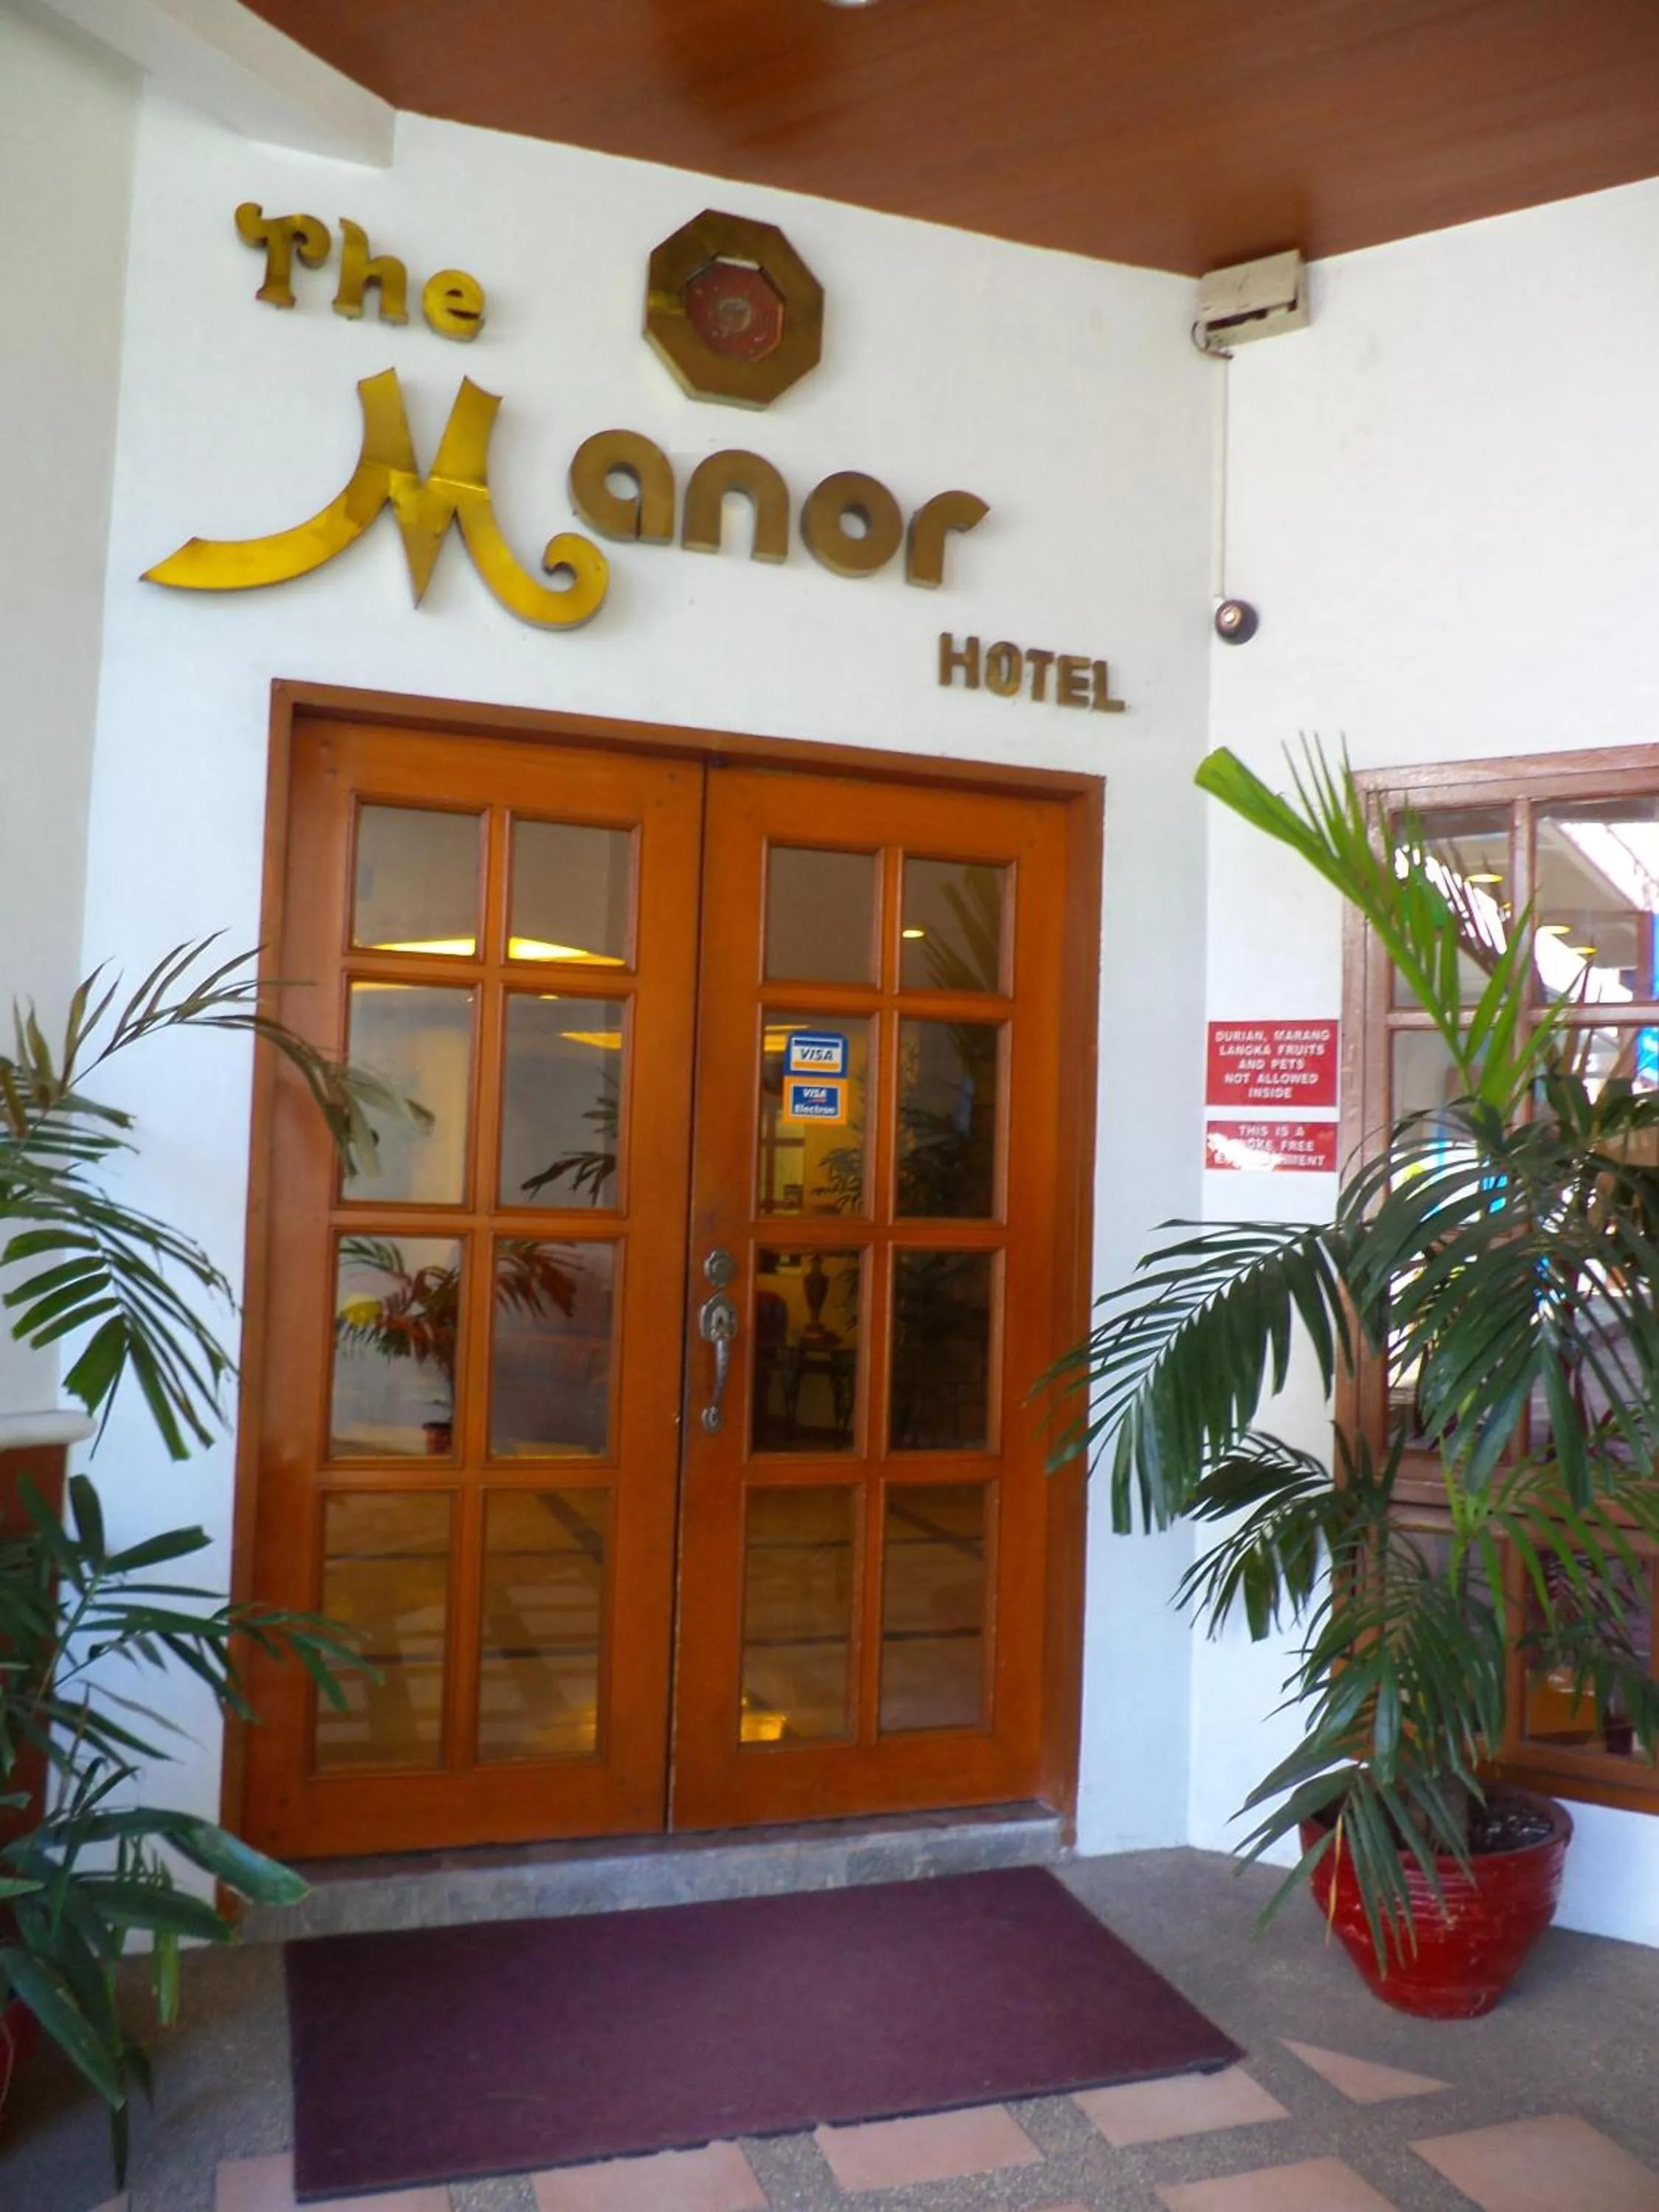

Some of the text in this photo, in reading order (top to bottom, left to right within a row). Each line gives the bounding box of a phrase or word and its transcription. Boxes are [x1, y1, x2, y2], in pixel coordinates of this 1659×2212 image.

[235, 202, 484, 342] The
[139, 367, 990, 631] Manor
[939, 631, 1125, 712] HOTEL
[1273, 1029, 1331, 1041] MARANG
[801, 1048, 834, 1060] VISA
[1219, 1044, 1324, 1056] LANGKA FRUITS
[1239, 1058, 1305, 1069] AND PETS
[1224, 1073, 1319, 1084] NOT ALLOWED
[803, 1088, 827, 1098] VISA
[1248, 1088, 1293, 1098] INSIDE
[794, 1104, 835, 1114] Electron
[1239, 1125, 1305, 1136] THIS IS A
[1280, 1140, 1315, 1152] FREE
